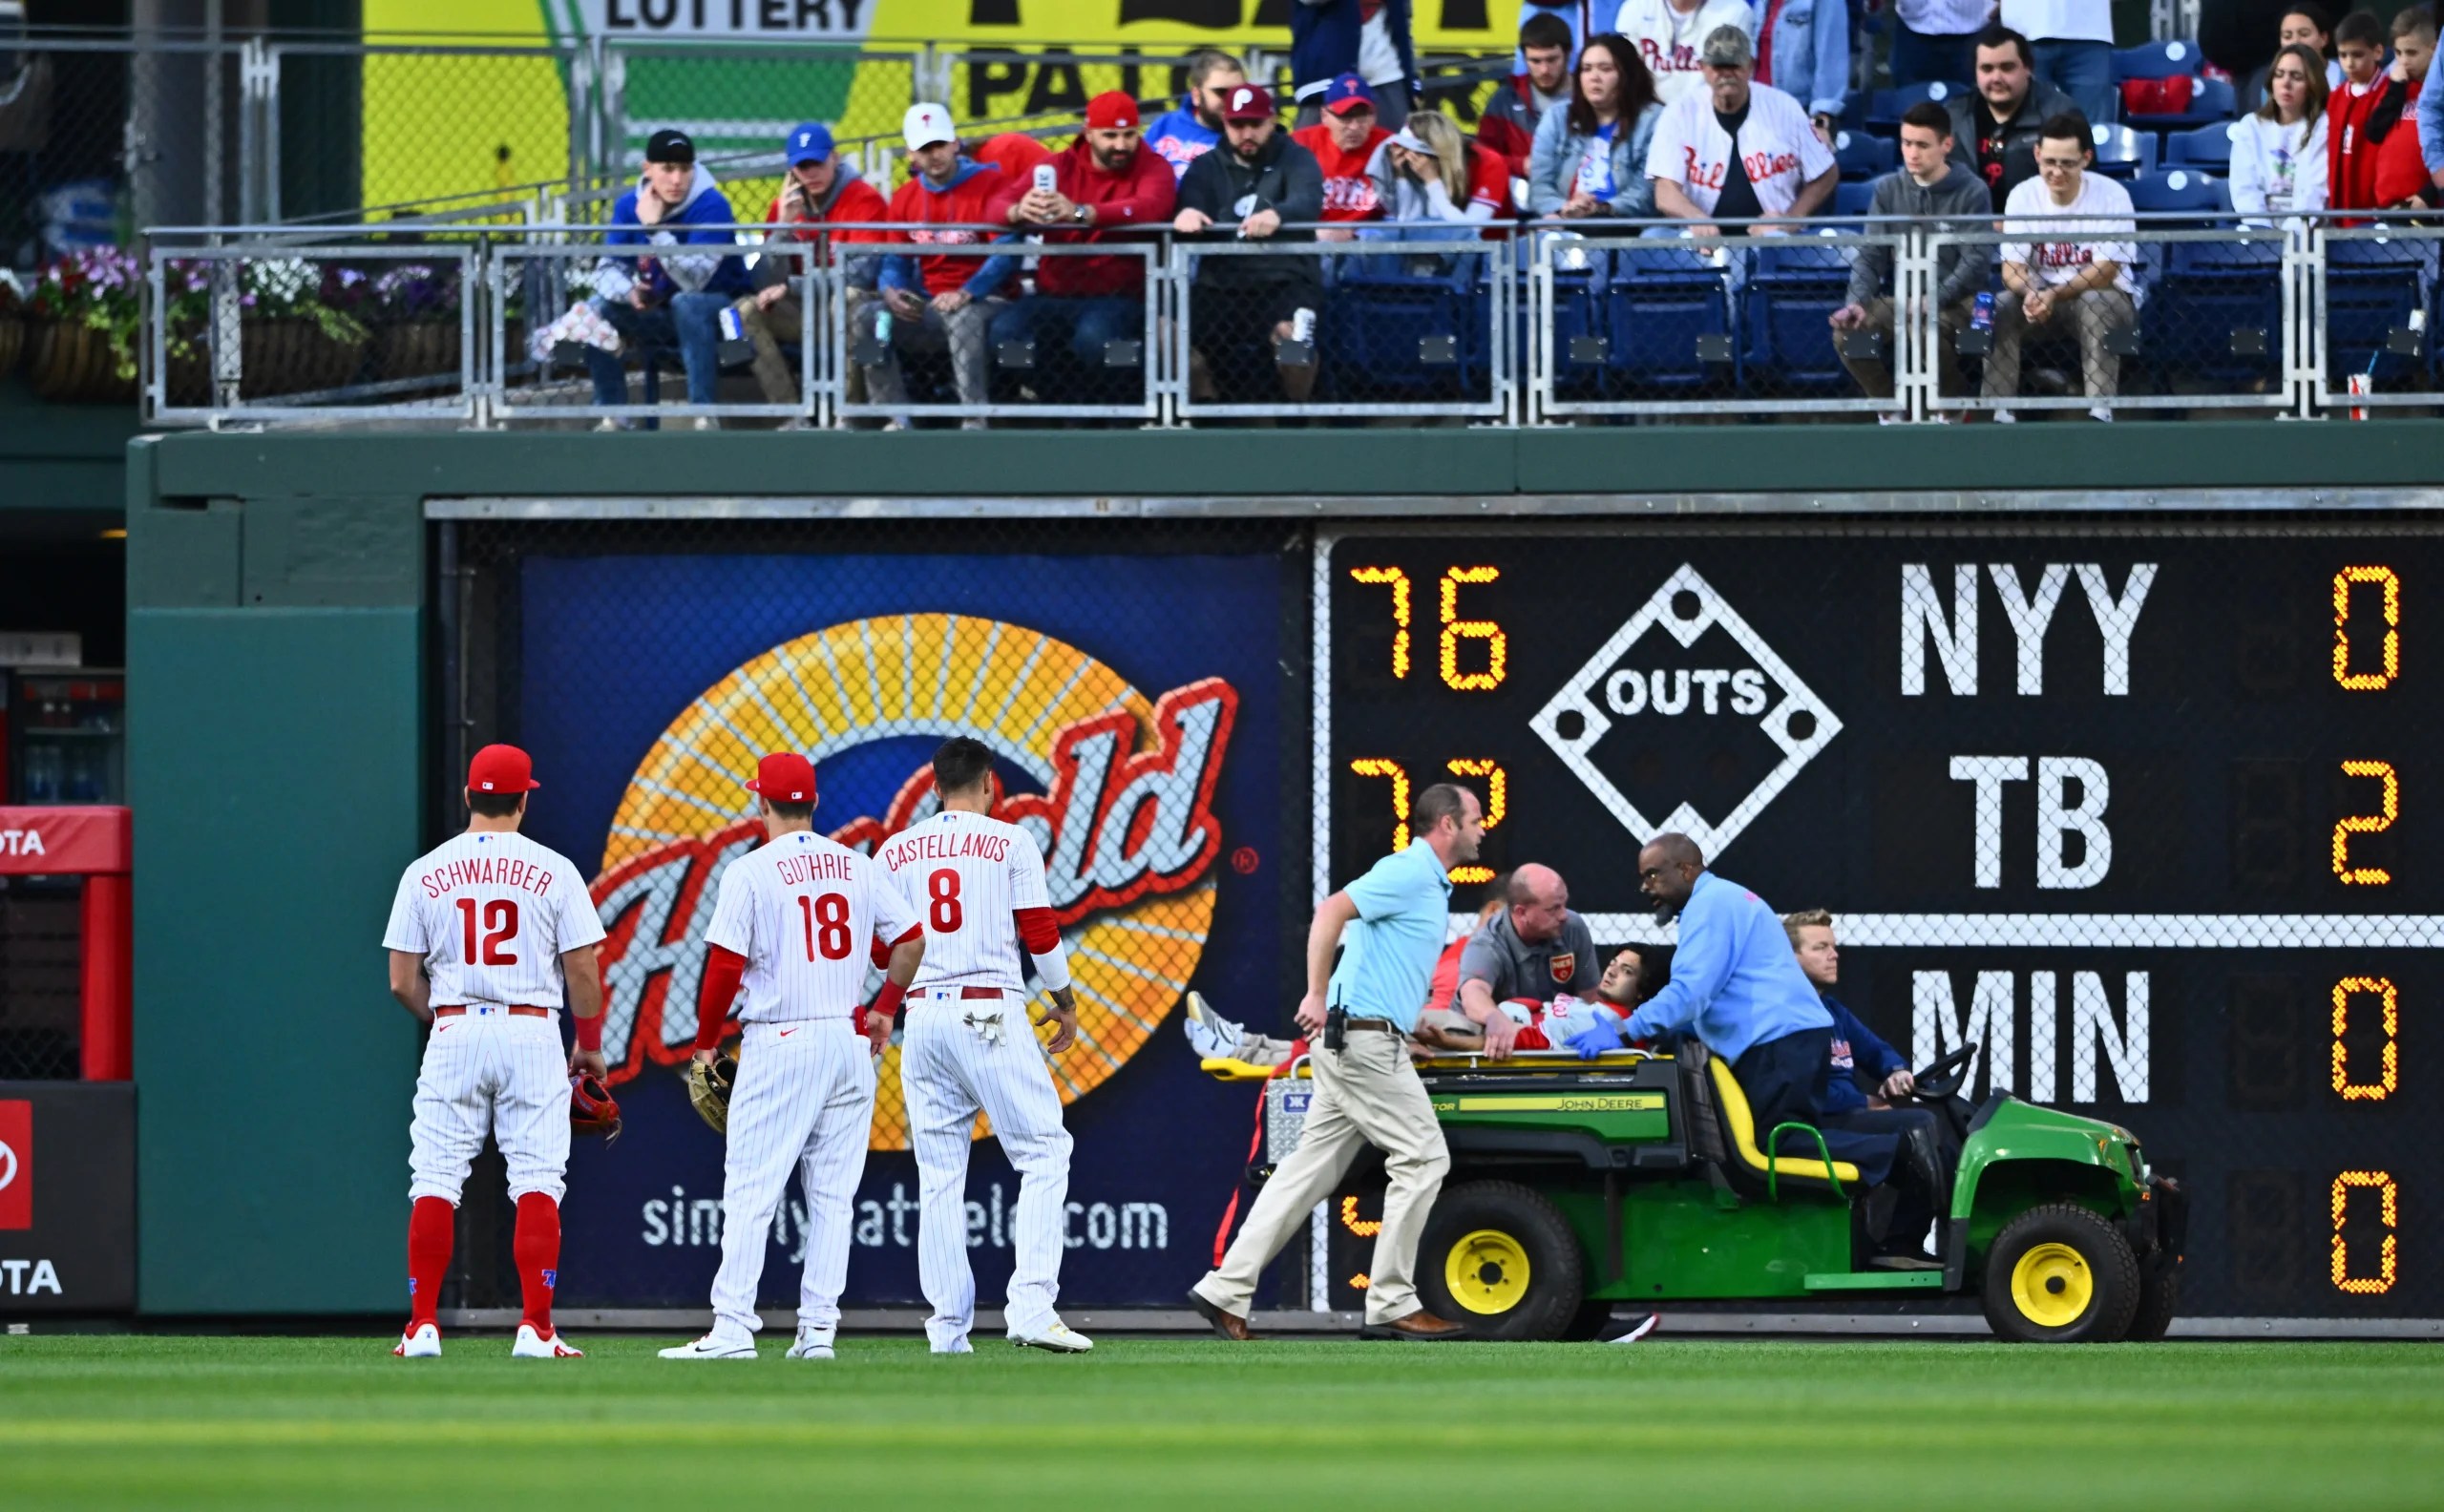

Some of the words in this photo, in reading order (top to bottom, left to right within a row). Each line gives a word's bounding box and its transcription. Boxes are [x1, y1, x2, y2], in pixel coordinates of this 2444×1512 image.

[1350, 566, 1506, 690] 76
[1902, 563, 2159, 696] NYY
[2333, 565, 2399, 690] 0
[1605, 668, 1767, 716] OUTS
[776, 852, 853, 886] GUTHRIE
[884, 832, 1010, 872] CASTELLANOS
[1949, 755, 2113, 889] TB
[2332, 760, 2398, 884] 2
[421, 857, 553, 899] SCHWARBER
[929, 868, 963, 934] 8
[455, 897, 519, 966] 12
[797, 892, 853, 963] 18
[1912, 970, 2150, 1103] MIN
[2332, 976, 2397, 1101] 0
[1556, 1098, 1595, 1110] JOHN
[1597, 1098, 1643, 1109] DEERE
[2332, 1170, 2397, 1293] 0
